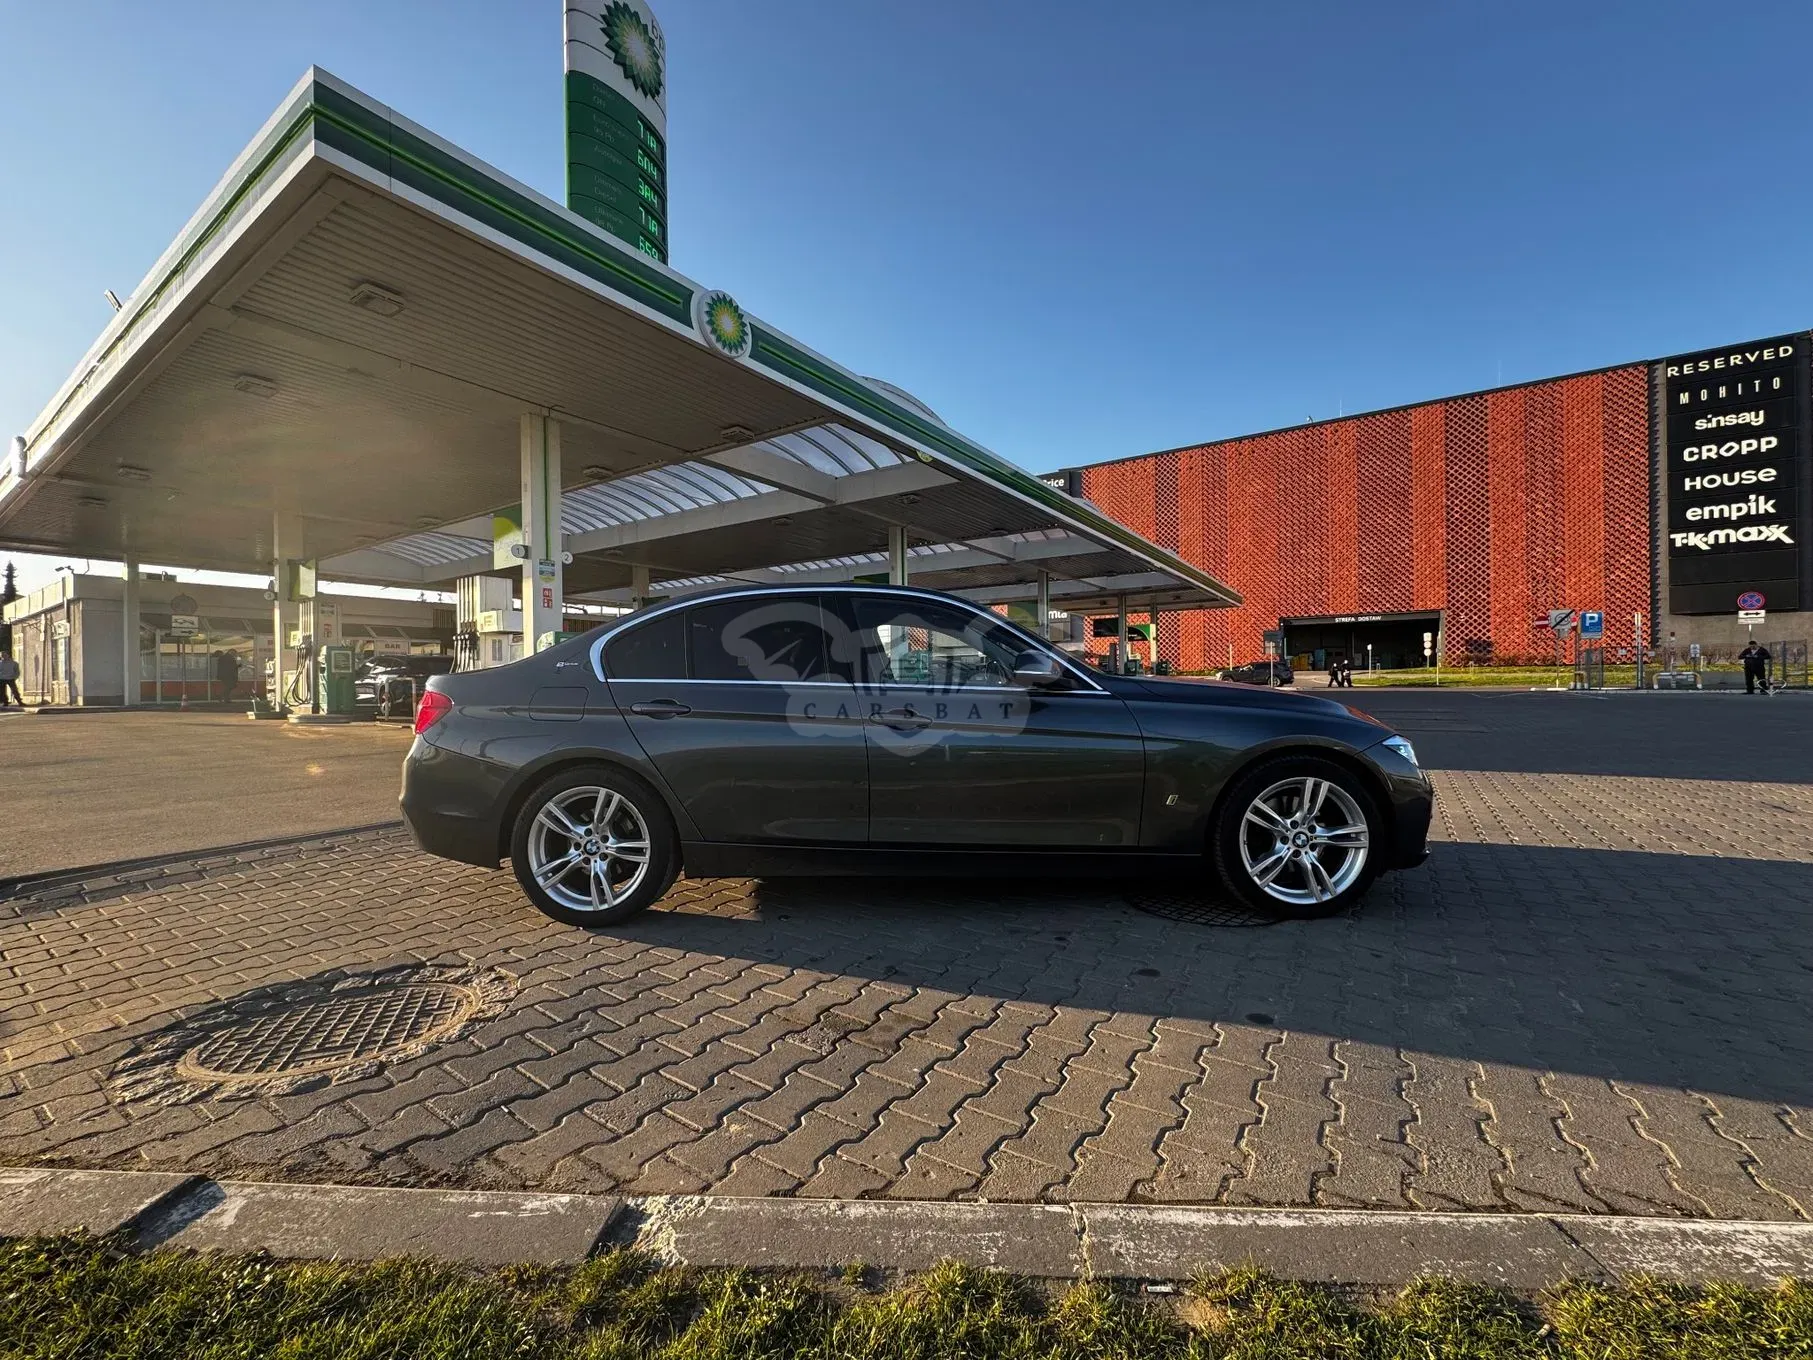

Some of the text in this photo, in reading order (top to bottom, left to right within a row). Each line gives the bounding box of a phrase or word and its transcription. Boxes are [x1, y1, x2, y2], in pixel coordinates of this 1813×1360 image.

[1667, 346, 1793, 378] RESERVED
[1679, 377, 1781, 405] MOHITO
[1695, 409, 1765, 430] sinsay
[1683, 436, 1778, 462] CROPP
[1686, 494, 1776, 521] empik
[1585, 613, 1599, 627] P
